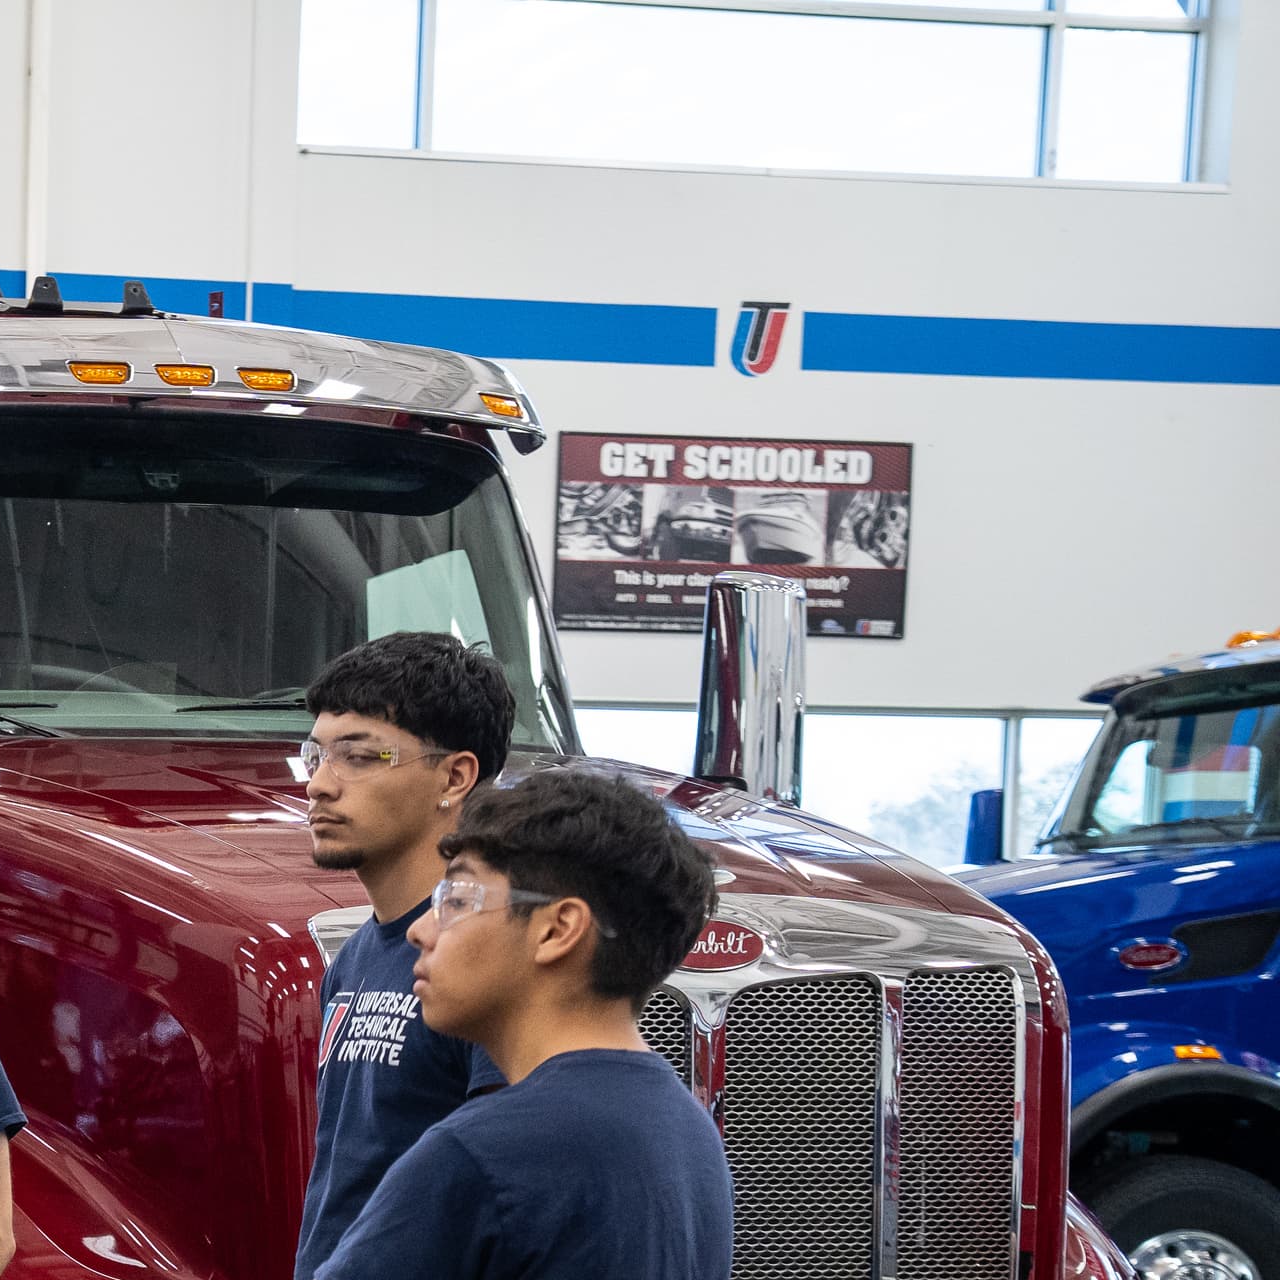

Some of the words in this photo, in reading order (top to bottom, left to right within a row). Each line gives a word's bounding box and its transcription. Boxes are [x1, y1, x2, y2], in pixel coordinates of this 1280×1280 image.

[600, 442, 675, 478] GET
[683, 445, 873, 485] SCHOOLED
[347, 1015, 408, 1042] TEHNICAL
